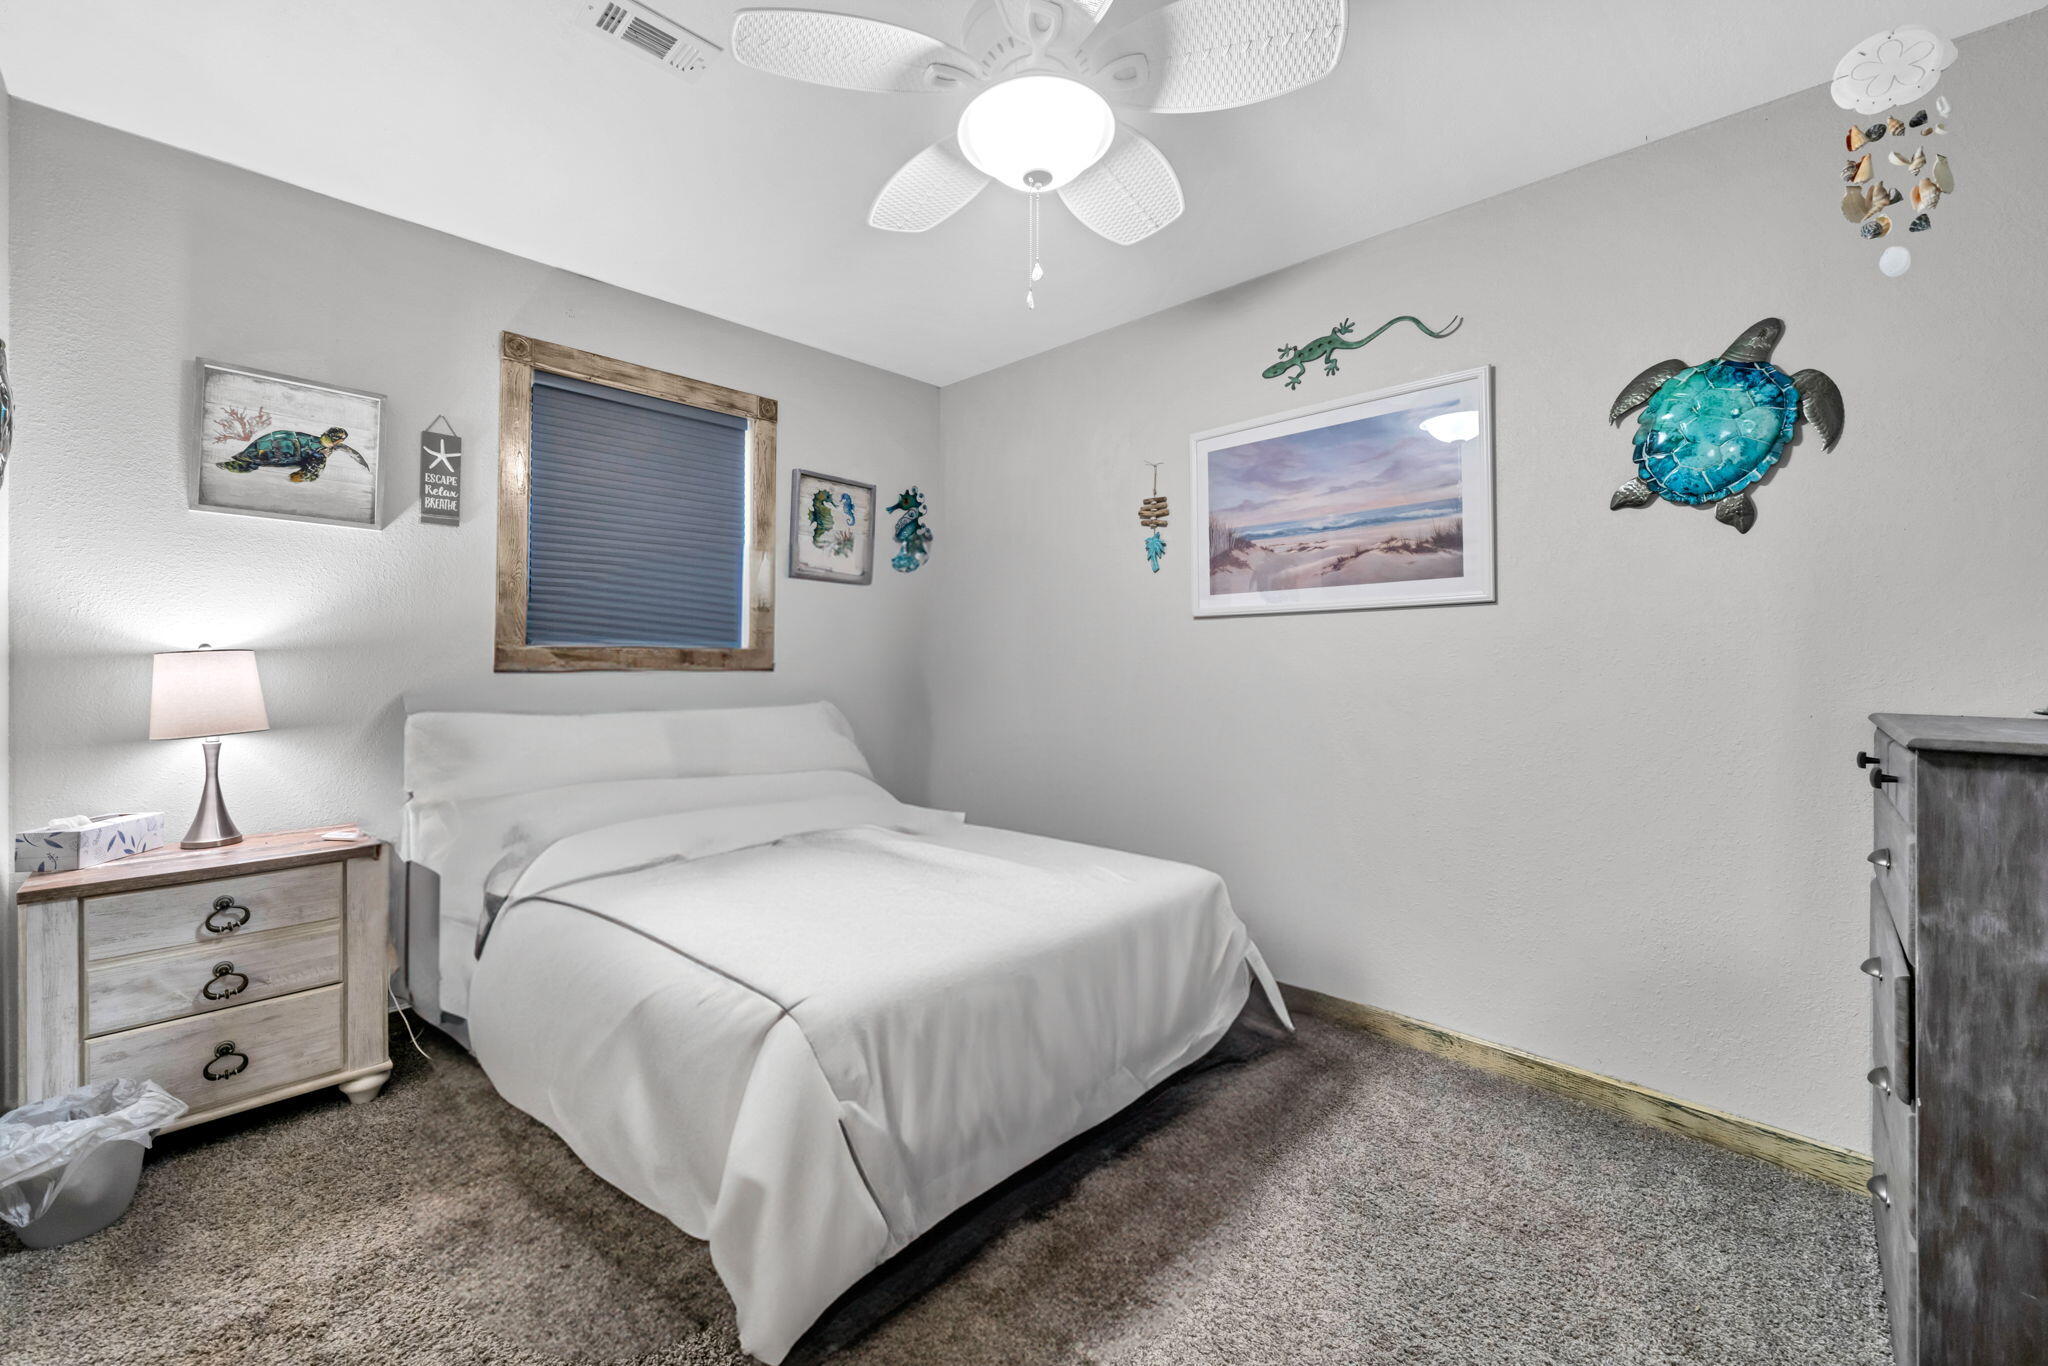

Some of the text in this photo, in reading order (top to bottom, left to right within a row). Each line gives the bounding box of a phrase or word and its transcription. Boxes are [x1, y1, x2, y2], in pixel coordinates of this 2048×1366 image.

[425, 473, 458, 486] ESCAPE
[425, 484, 459, 498] Relax
[425, 497, 458, 511] BREATHE
